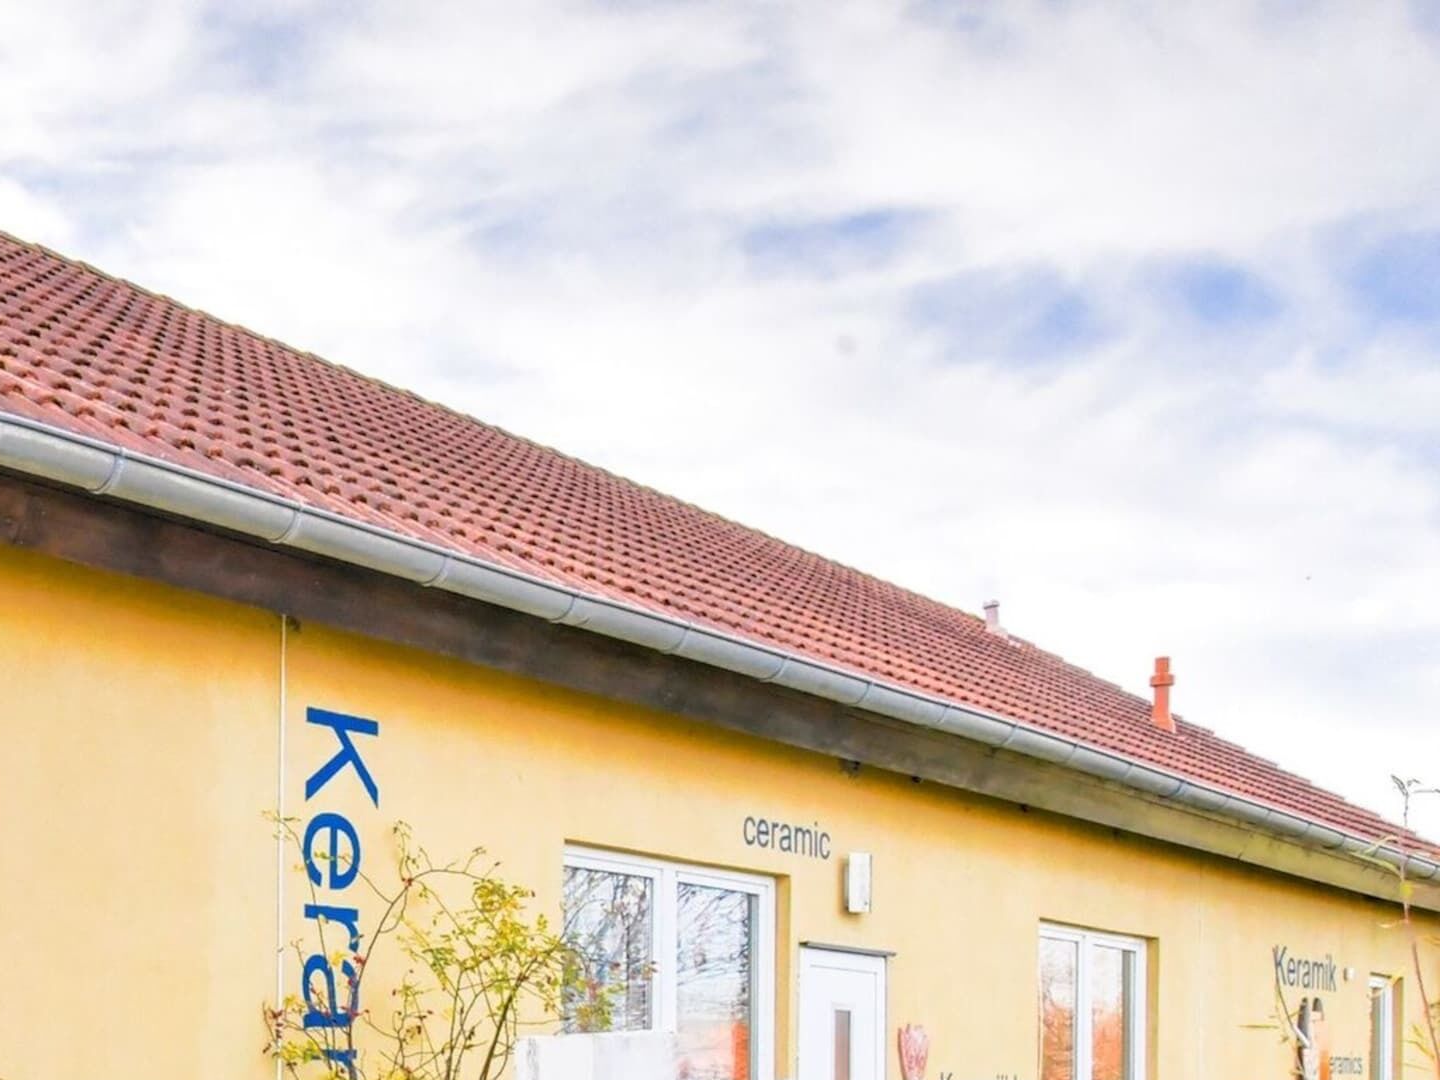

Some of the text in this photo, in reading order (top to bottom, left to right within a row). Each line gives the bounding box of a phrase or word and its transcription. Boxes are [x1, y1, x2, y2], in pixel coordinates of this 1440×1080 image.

[743, 815, 831, 860] ceramic
[1273, 945, 1337, 992] Keramik
[1327, 1051, 1363, 1075] eramics
